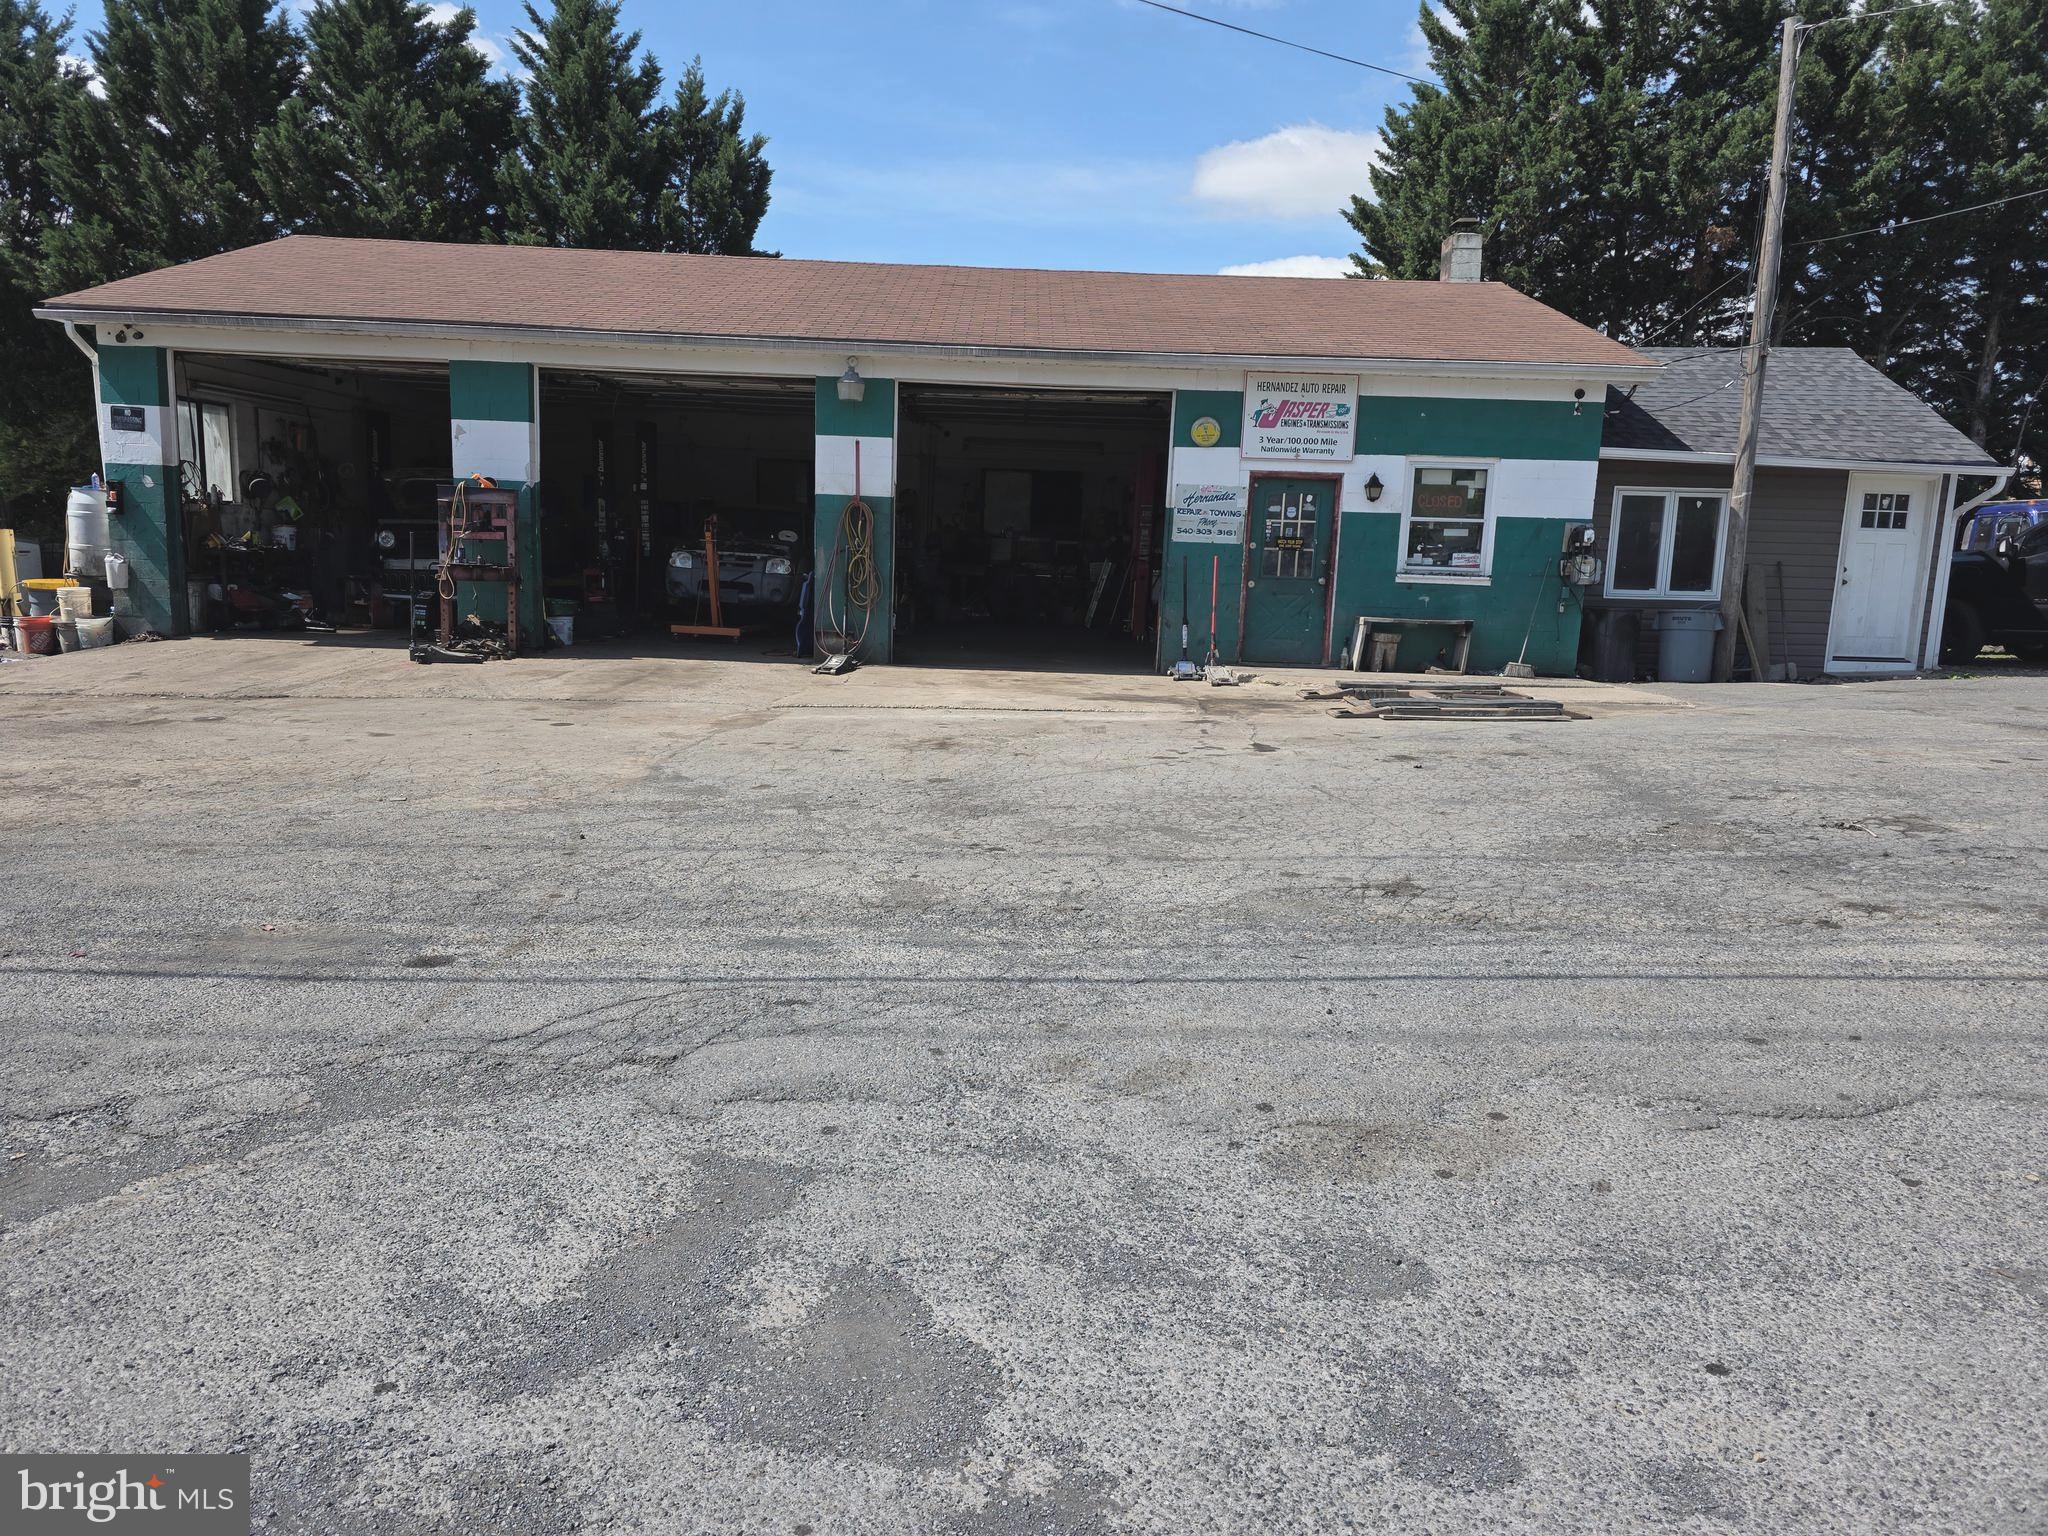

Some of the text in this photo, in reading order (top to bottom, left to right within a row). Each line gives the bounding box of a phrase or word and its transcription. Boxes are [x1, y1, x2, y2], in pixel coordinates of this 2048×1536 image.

[1257, 381, 1346, 394] HERNANDEZ AUTO REPAIR
[1258, 400, 1330, 428] JASPER
[1280, 419, 1303, 428] ENGINES
[1307, 419, 1349, 429] TRANSMISSIONS
[1320, 438, 1338, 446] Mile
[1261, 445, 1335, 456] Nationwide Warranty
[1183, 491, 1236, 507] Hernandez
[1418, 495, 1463, 508] CLOSED
[1209, 509, 1242, 518] TOWING
